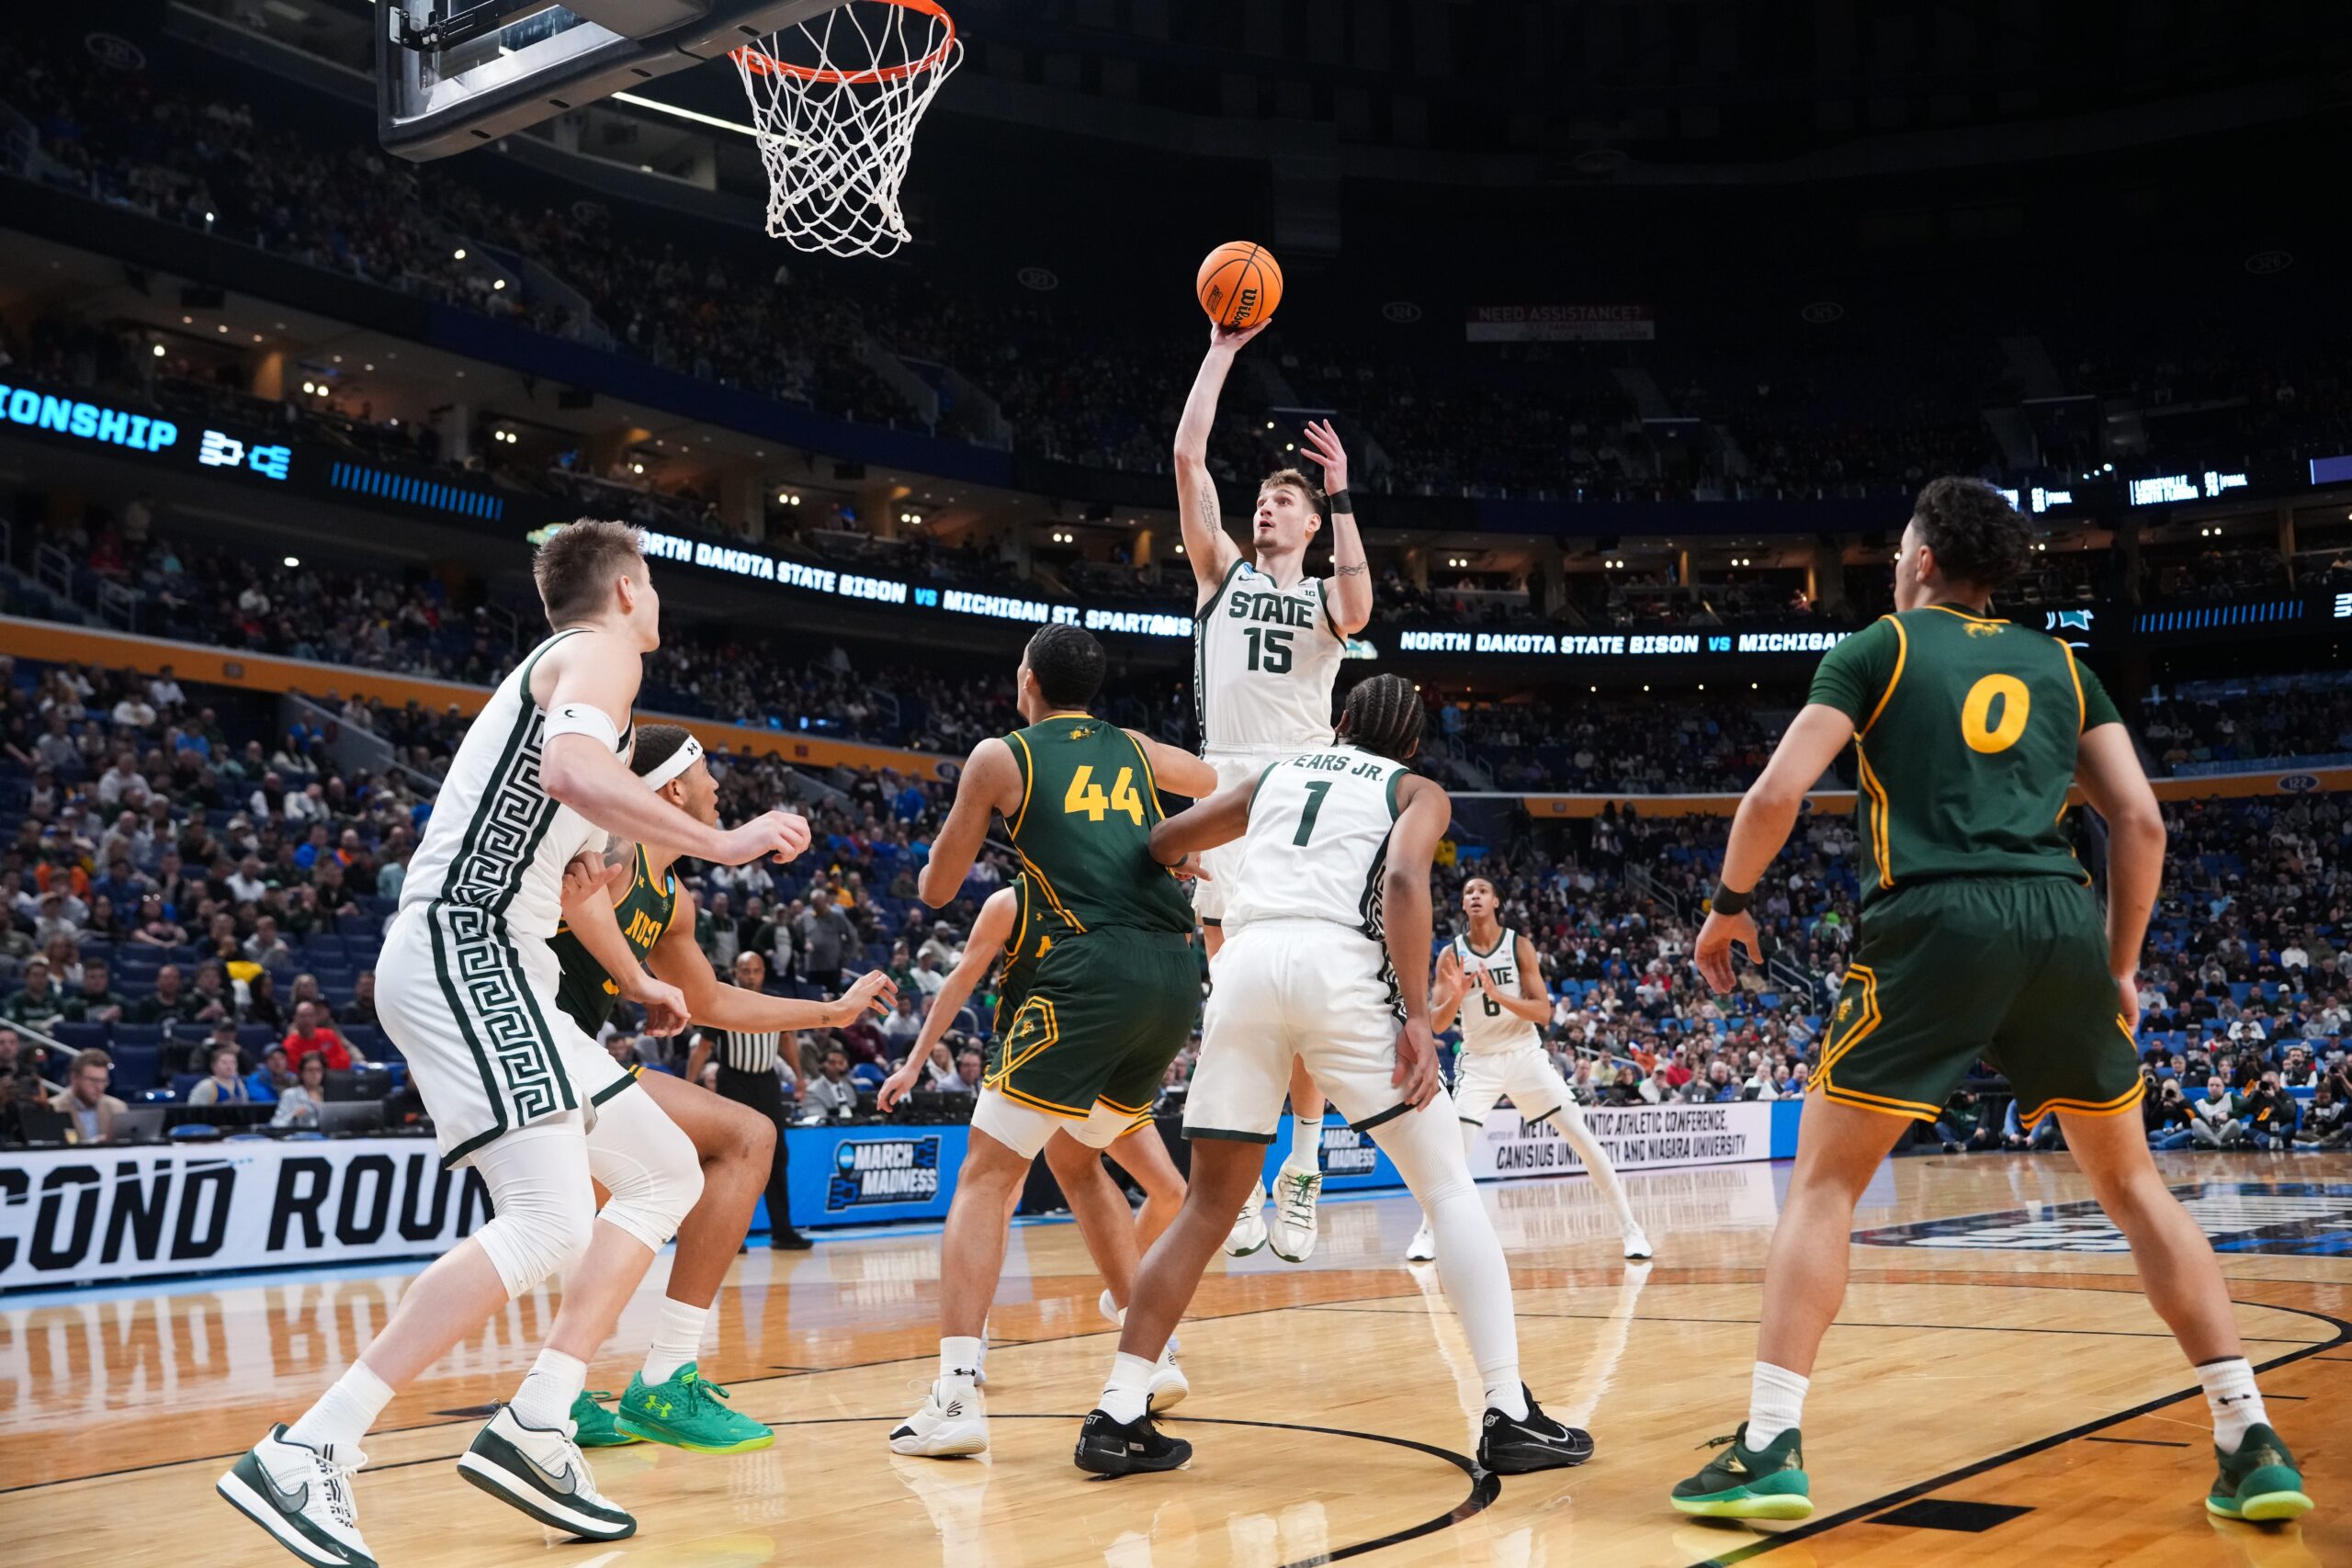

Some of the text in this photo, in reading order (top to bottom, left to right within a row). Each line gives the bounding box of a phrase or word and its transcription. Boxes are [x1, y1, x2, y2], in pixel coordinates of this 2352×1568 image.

[1478, 306, 1642, 321] NEED ASSISTANCE?
[2222, 474, 2247, 487] FINAL
[695, 543, 774, 580] DAKOTA
[777, 560, 836, 592] STATE
[839, 573, 907, 604] BISON
[915, 588, 937, 606] VS
[943, 589, 1049, 623] MICHIGAN
[1051, 605, 1081, 626] ST.
[1085, 609, 1193, 637] SPARTANS
[1228, 591, 1316, 629] STATE
[1244, 627, 1295, 674] 15
[1400, 632, 1471, 651] NORTH
[1476, 633, 1556, 654] DAKOTA
[1560, 636, 1625, 654] STATE
[1629, 635, 1700, 654] BISON
[1708, 637, 1732, 651] VS
[1962, 673, 2030, 754] 0
[1282, 754, 1384, 781] EARS JR.
[1064, 765, 1145, 827] 44
[2289, 777, 2308, 790] 122
[1293, 780, 1333, 847] 1
[1482, 992, 1500, 1017] 6
[1584, 1112, 1614, 1136] ANTIC
[1615, 1111, 1662, 1135] ATHLETIC
[1665, 1110, 1729, 1133] CONFERENCE,
[1323, 1129, 1360, 1148] MARCH
[854, 1144, 914, 1169] MARCH
[1328, 1148, 1376, 1168] MADNESS
[1497, 1134, 1747, 1170] CANISIUS UNIITY AND NIAGARA UNIVERSITY
[862, 1168, 937, 1195] MADNESS
